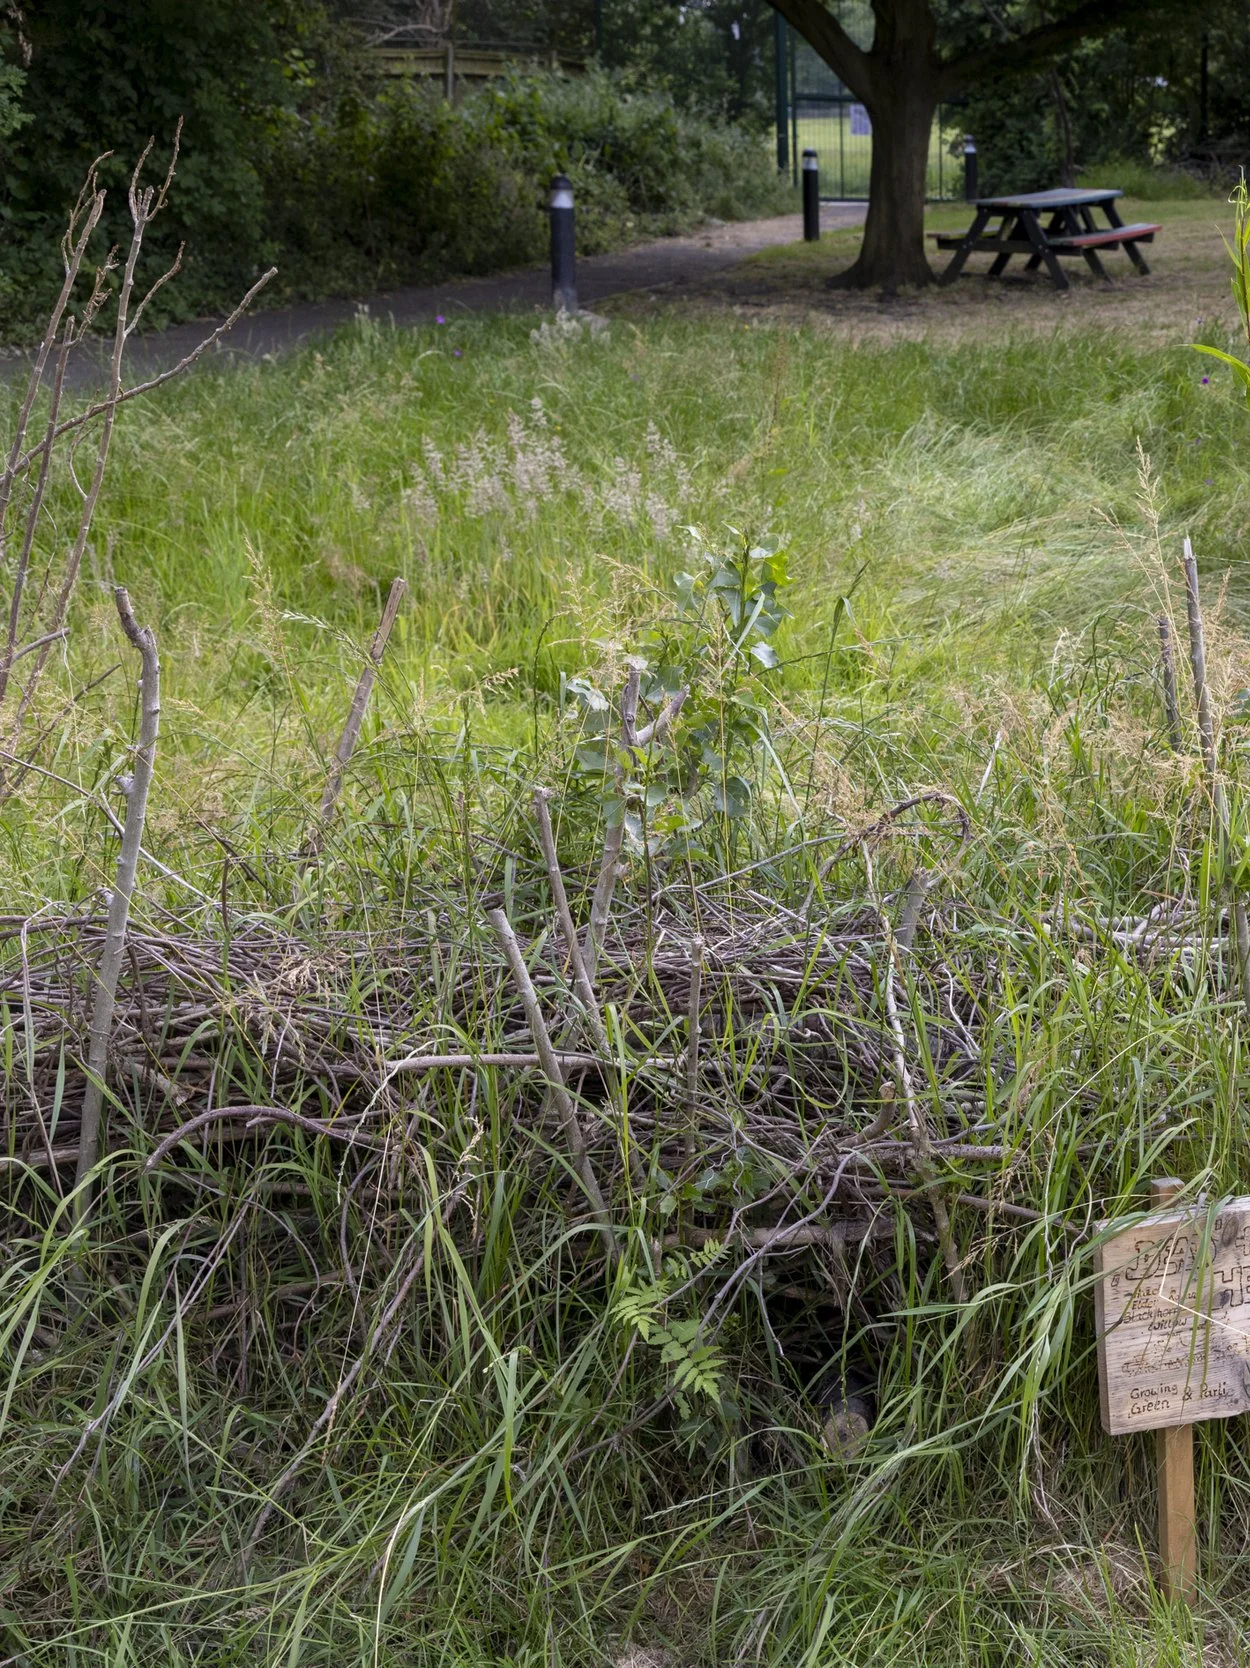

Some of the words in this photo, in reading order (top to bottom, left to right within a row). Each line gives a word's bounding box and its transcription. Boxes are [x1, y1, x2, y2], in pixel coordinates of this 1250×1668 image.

[1123, 1306, 1179, 1324] Blackhorn
[1129, 1382, 1179, 1400] Growing
[1182, 1386, 1193, 1401] &
[1130, 1399, 1171, 1415] Green
